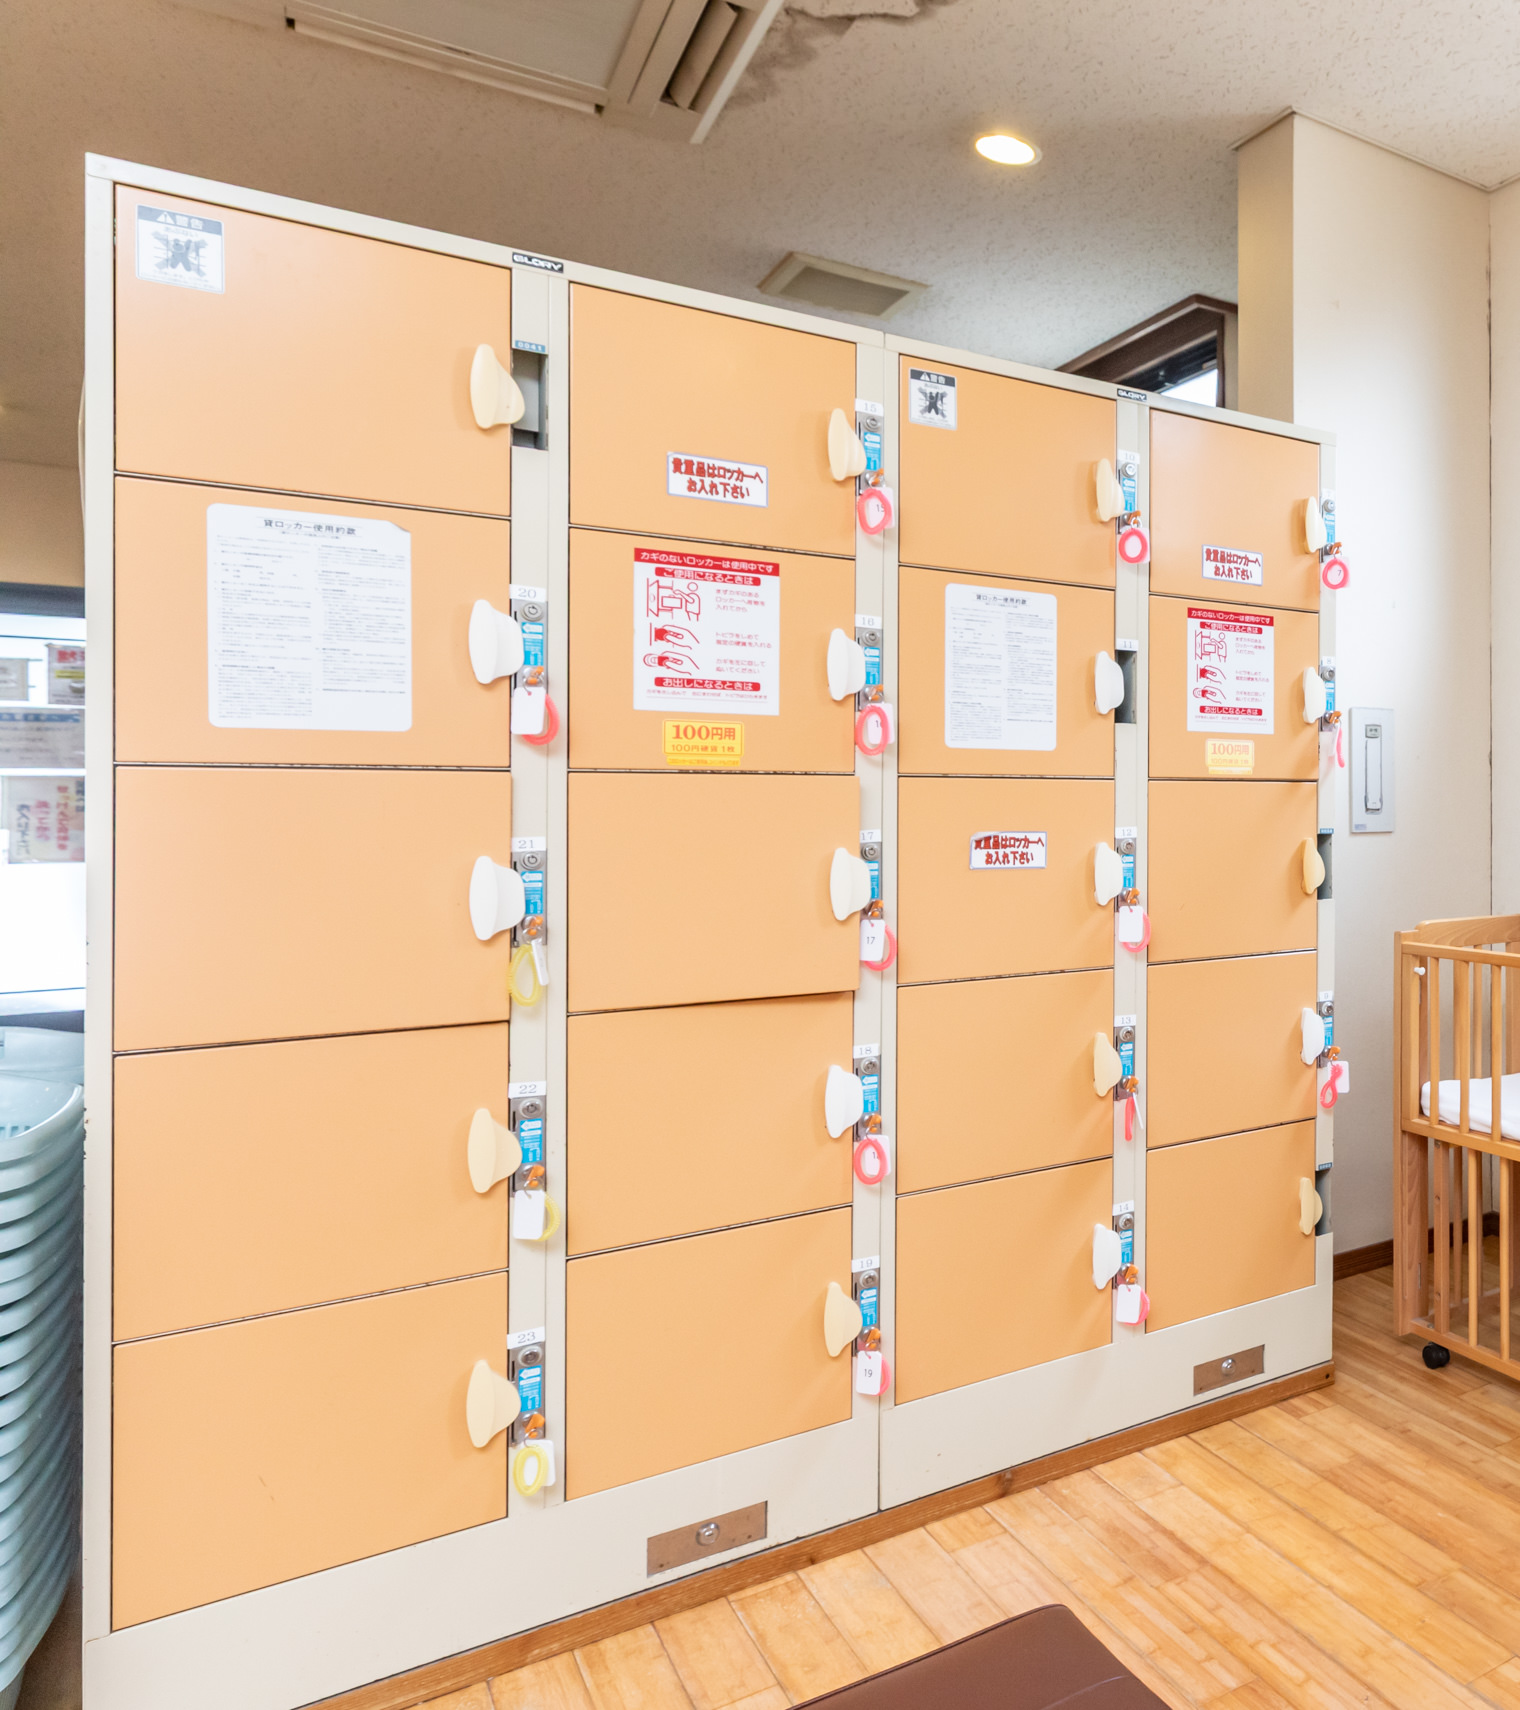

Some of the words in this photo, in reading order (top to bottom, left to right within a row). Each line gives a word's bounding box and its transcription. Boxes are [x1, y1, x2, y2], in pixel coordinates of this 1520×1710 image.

[513, 254, 562, 271] GLORY
[1118, 388, 1146, 401] GLORY
[864, 402, 877, 413] 15
[672, 457, 764, 484] 貴重品はロッカーへ
[687, 477, 750, 499] お入れ下さい
[640, 551, 774, 573] カギのないロッカーは使用中です
[663, 567, 754, 586] ご使用になるときは
[518, 587, 537, 599] 20
[662, 678, 754, 691] お出しになるときは
[671, 724, 736, 741] 100円用
[861, 831, 874, 841] 17
[1121, 828, 1132, 837] 12
[518, 839, 536, 849] 21
[985, 850, 1034, 865] お入れ下さい
[866, 936, 876, 945] 17
[1120, 1016, 1131, 1025] 13
[859, 1046, 872, 1056] 18
[519, 1083, 537, 1095] 22
[860, 1258, 873, 1270] 19
[517, 1331, 536, 1344] 23
[864, 1368, 873, 1378] 19
